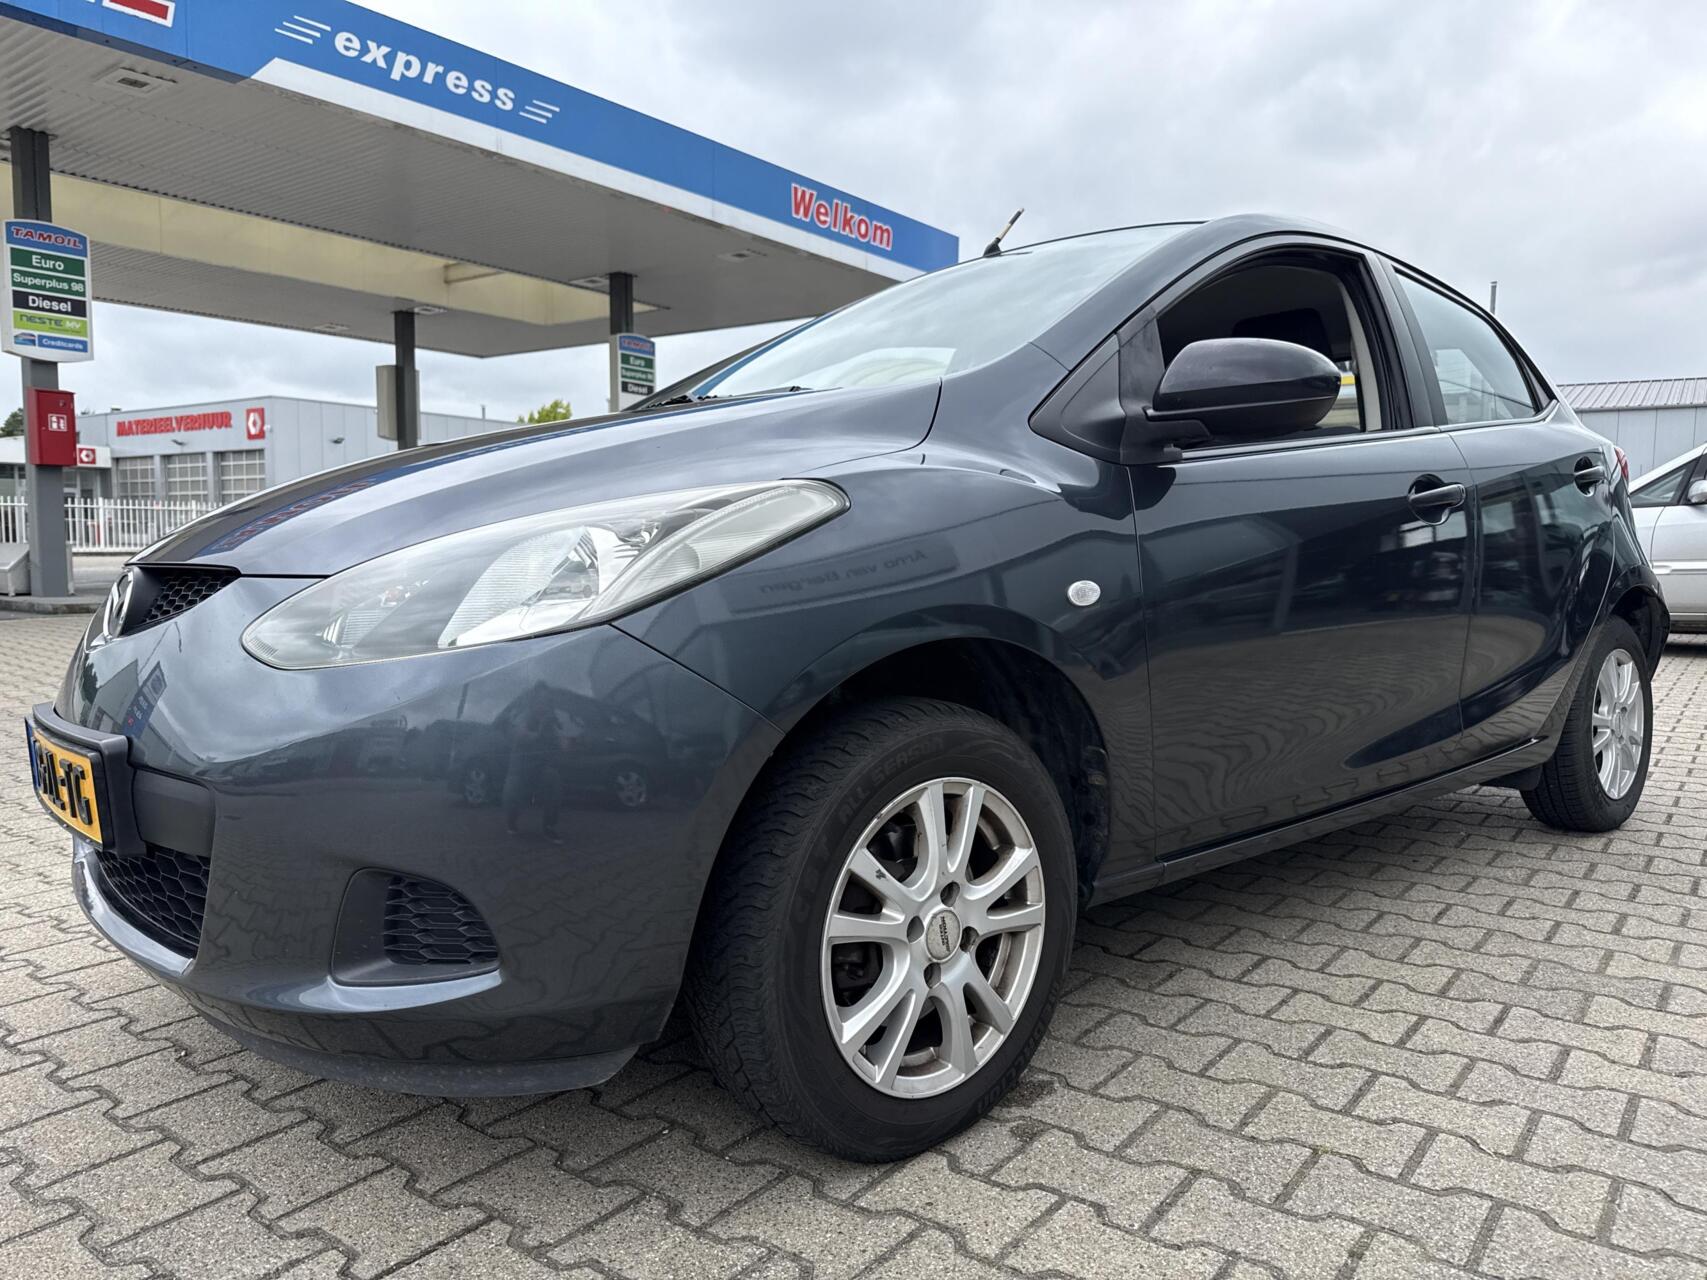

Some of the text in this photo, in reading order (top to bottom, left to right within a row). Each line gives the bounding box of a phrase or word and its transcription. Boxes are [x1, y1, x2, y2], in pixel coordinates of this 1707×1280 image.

[334, 30, 516, 112] express
[791, 183, 893, 251] Welkom
[11, 226, 83, 249] TAMOIL
[31, 254, 65, 271] Euro
[12, 272, 85, 293] Superplus 98
[28, 295, 72, 313] Diesel
